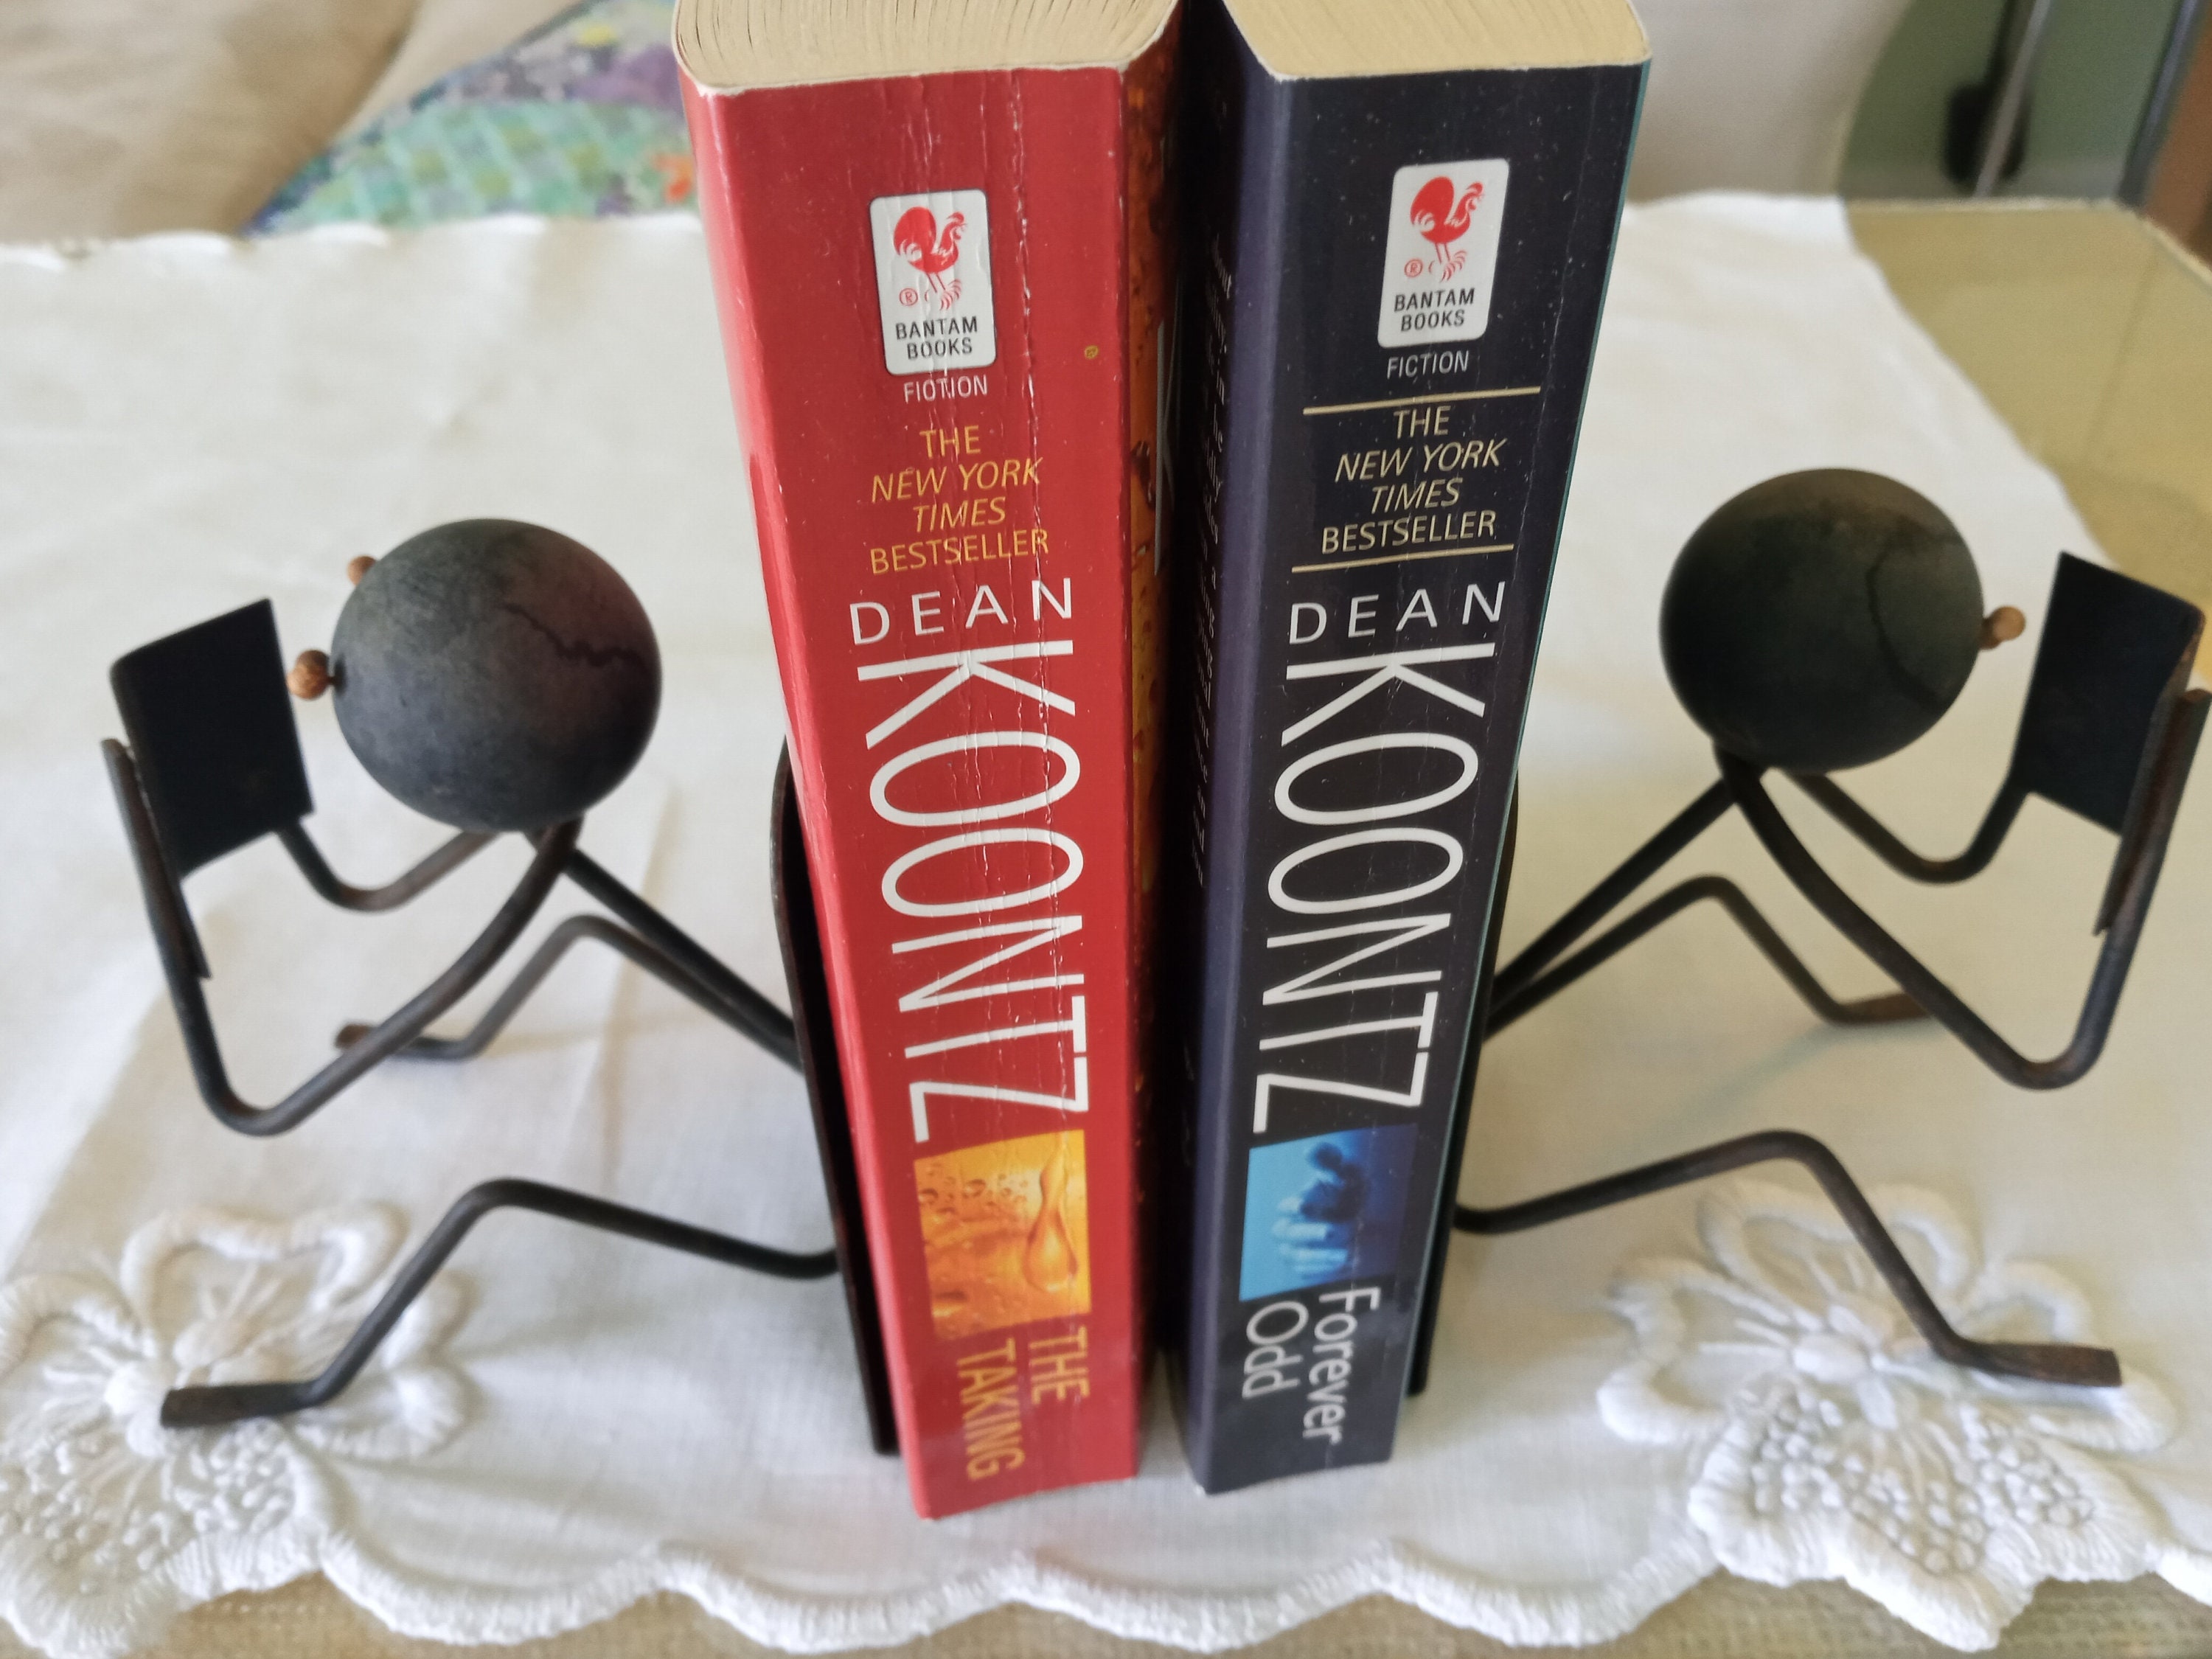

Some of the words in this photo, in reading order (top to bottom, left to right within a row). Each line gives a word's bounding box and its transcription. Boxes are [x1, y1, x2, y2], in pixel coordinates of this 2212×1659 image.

[1394, 287, 1475, 313] BANTAM
[1401, 309, 1465, 332] BOOKS
[895, 316, 978, 340] BANTAM
[906, 337, 973, 360] BOOKS
[1387, 349, 1469, 380] FICTION
[919, 425, 981, 459] THE
[1393, 405, 1451, 439] THE
[871, 466, 947, 504] NEW
[959, 456, 1043, 491] YORK
[1334, 446, 1413, 483] NEW
[1423, 437, 1508, 473] YORK
[913, 496, 1006, 532] TIMES
[1371, 477, 1464, 515] TIMES
[870, 529, 1049, 575] BESTSELLER
[1322, 509, 1496, 554] BESTSELLER
[849, 577, 1071, 645] DEAN
[1290, 581, 1506, 644] DEAN
[858, 639, 1088, 1144] KOONTZ
[1253, 642, 1495, 1133] KOONTZ
[1029, 1325, 1091, 1405] THE
[1242, 1301, 1309, 1399] Odd
[1302, 1287, 1381, 1445] Forever
[956, 1336, 1026, 1481] TAKING
